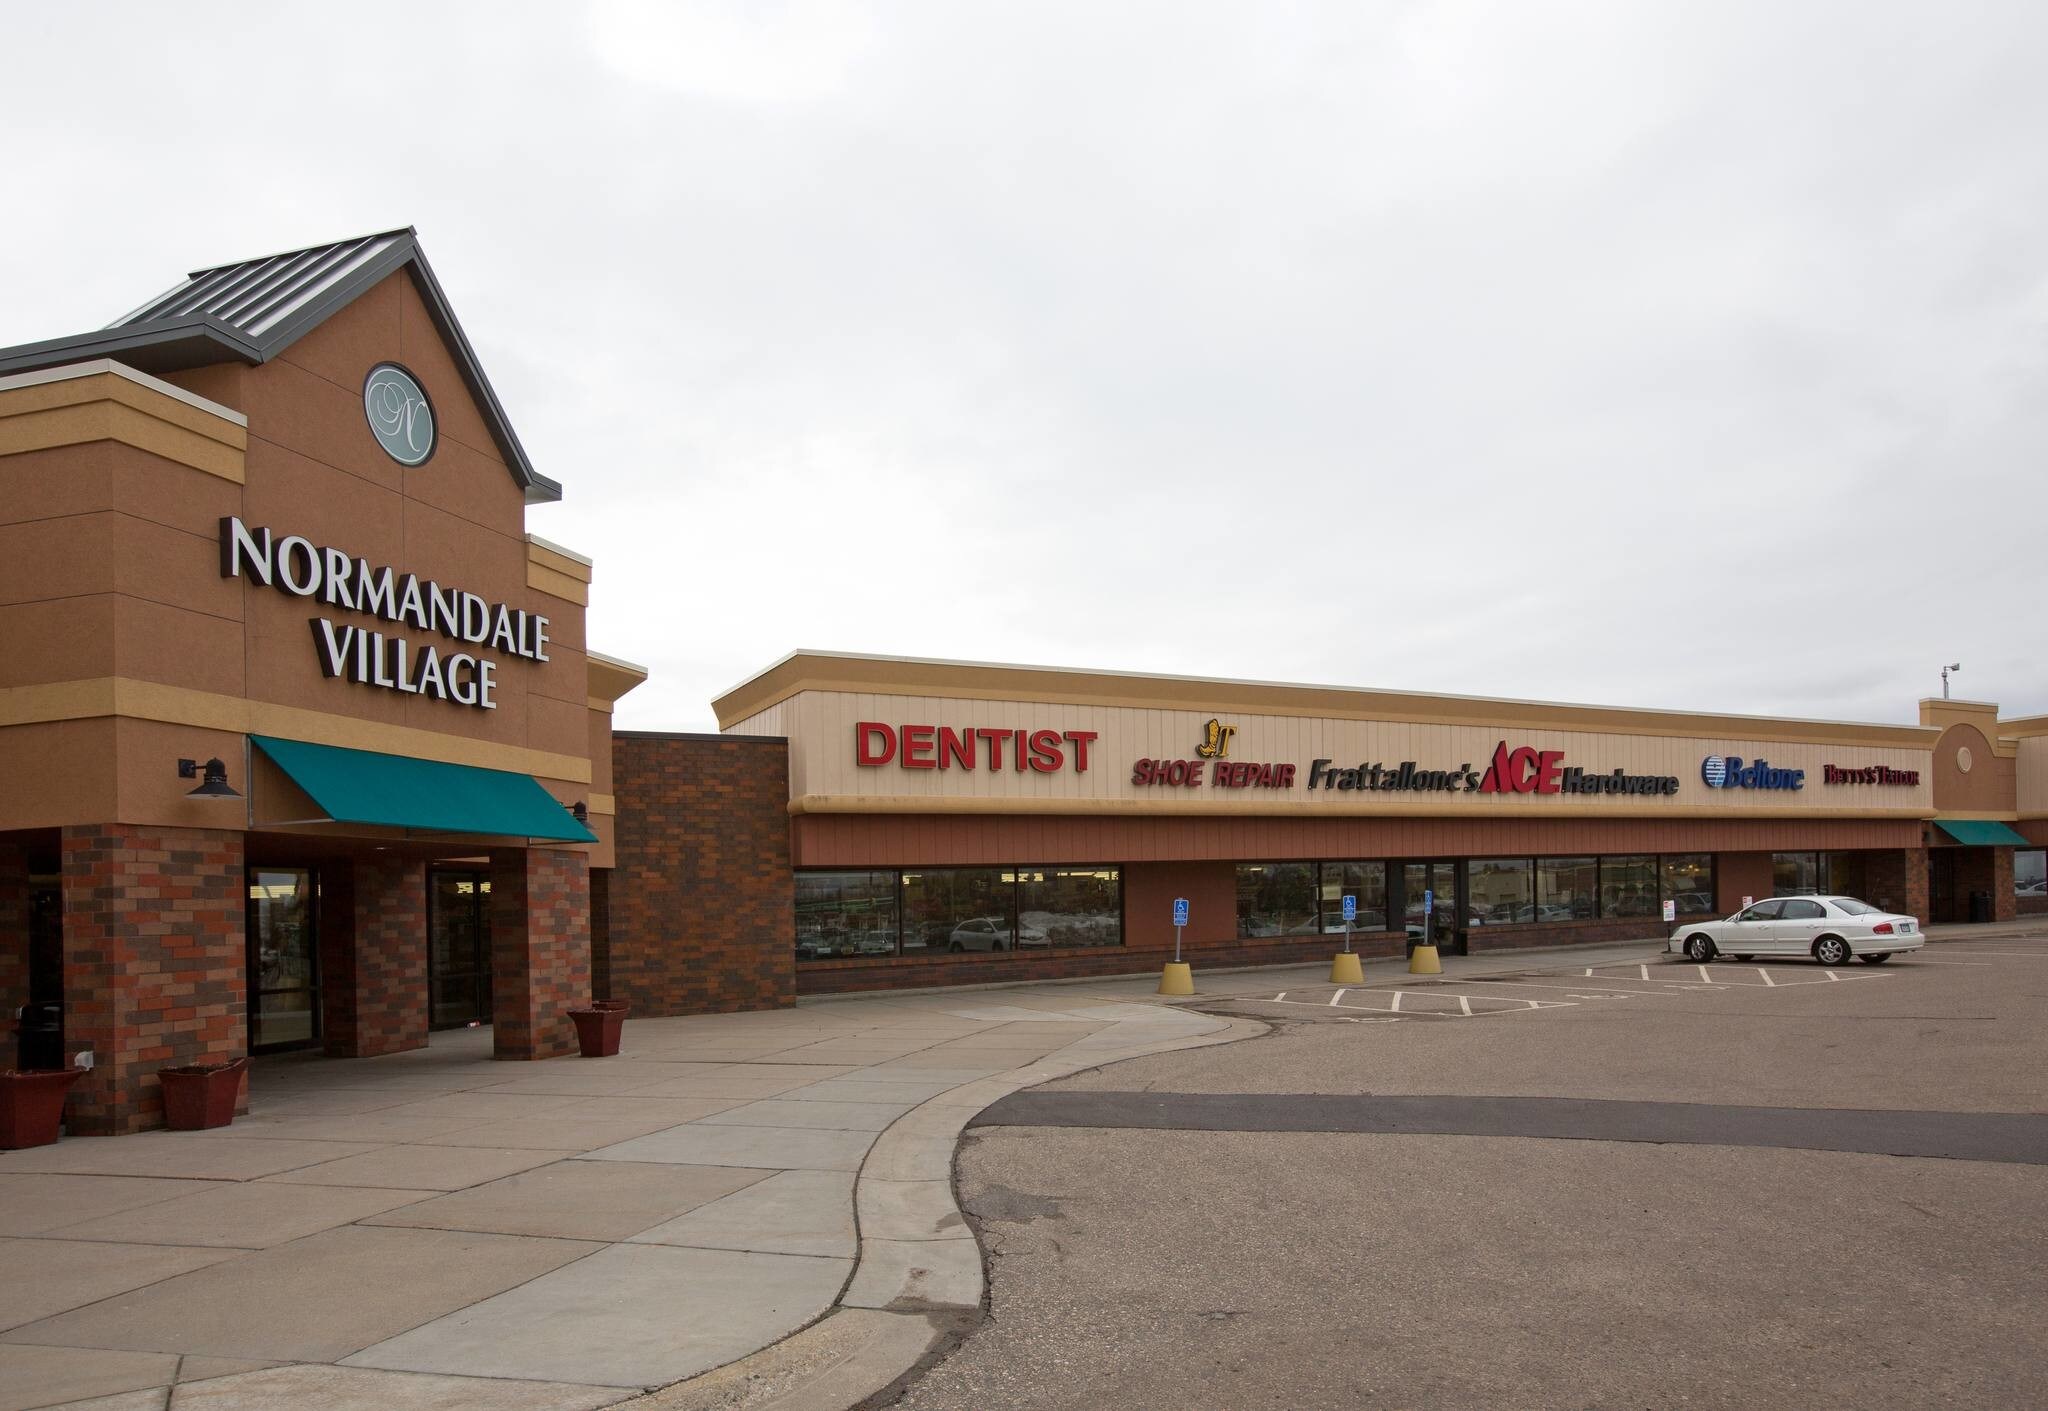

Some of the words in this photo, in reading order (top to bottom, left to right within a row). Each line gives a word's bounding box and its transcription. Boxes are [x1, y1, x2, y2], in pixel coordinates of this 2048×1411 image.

[219, 516, 550, 663] NORMANDALE
[309, 616, 497, 710] VILLAGE
[856, 721, 1098, 773] DENTIST
[1132, 758, 1206, 788] SHOE
[1211, 761, 1297, 789] REPAIR
[1308, 758, 1481, 792] Frattallone's
[1478, 740, 1565, 794] ACE
[1561, 766, 1680, 796] Hardware
[1723, 757, 1805, 791] Beltone
